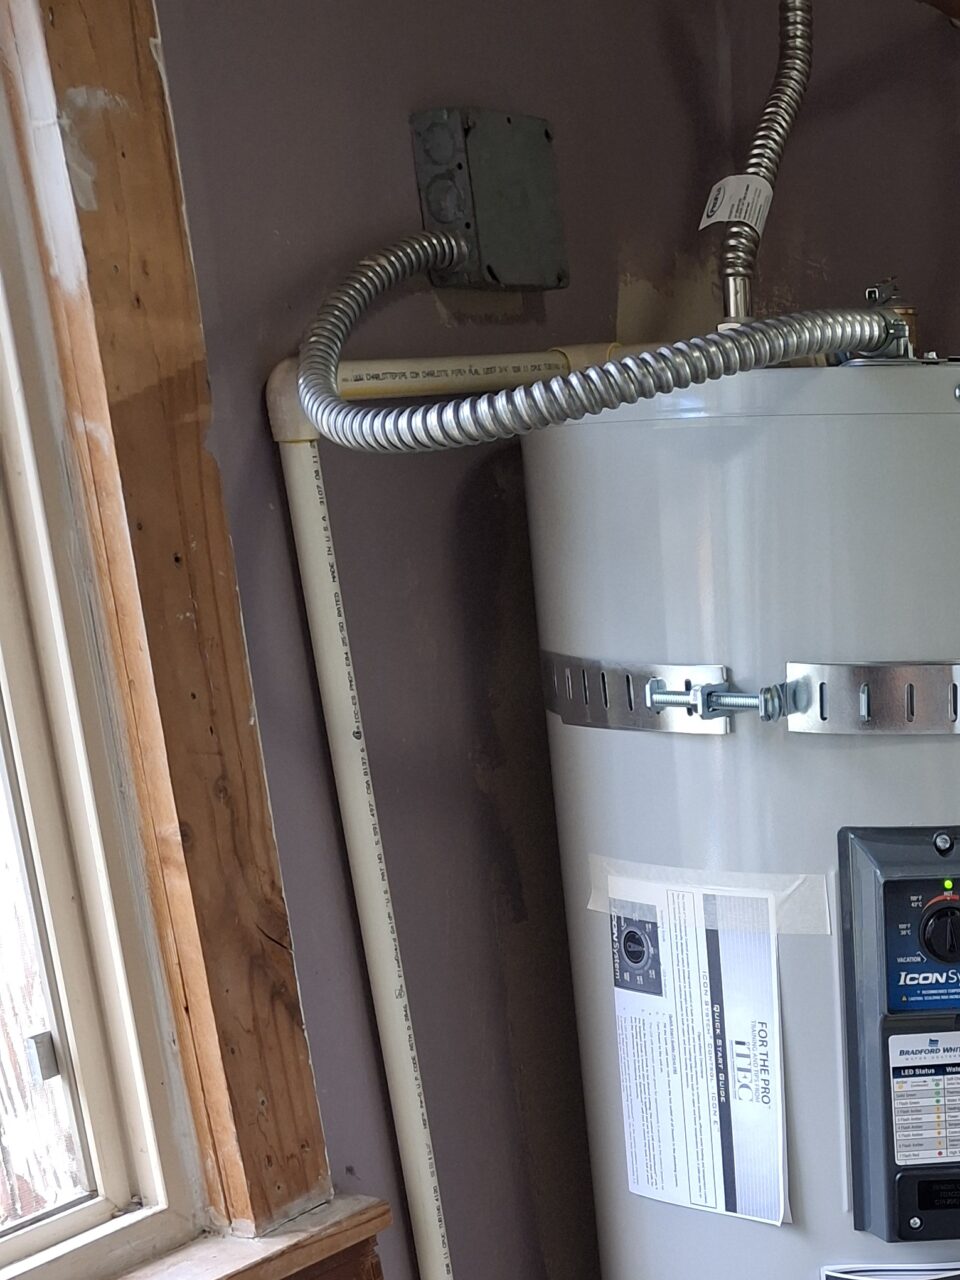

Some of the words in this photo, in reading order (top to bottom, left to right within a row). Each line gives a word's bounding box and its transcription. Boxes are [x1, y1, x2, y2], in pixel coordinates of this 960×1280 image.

[713, 1004, 721, 1035] QUICK
[757, 1021, 768, 1048] FOR
[715, 1038, 724, 1071] START
[759, 1050, 770, 1076] THE
[899, 1048, 941, 1057] BRADFORD
[901, 1068, 914, 1076] LED
[718, 1072, 726, 1103] GUIDE
